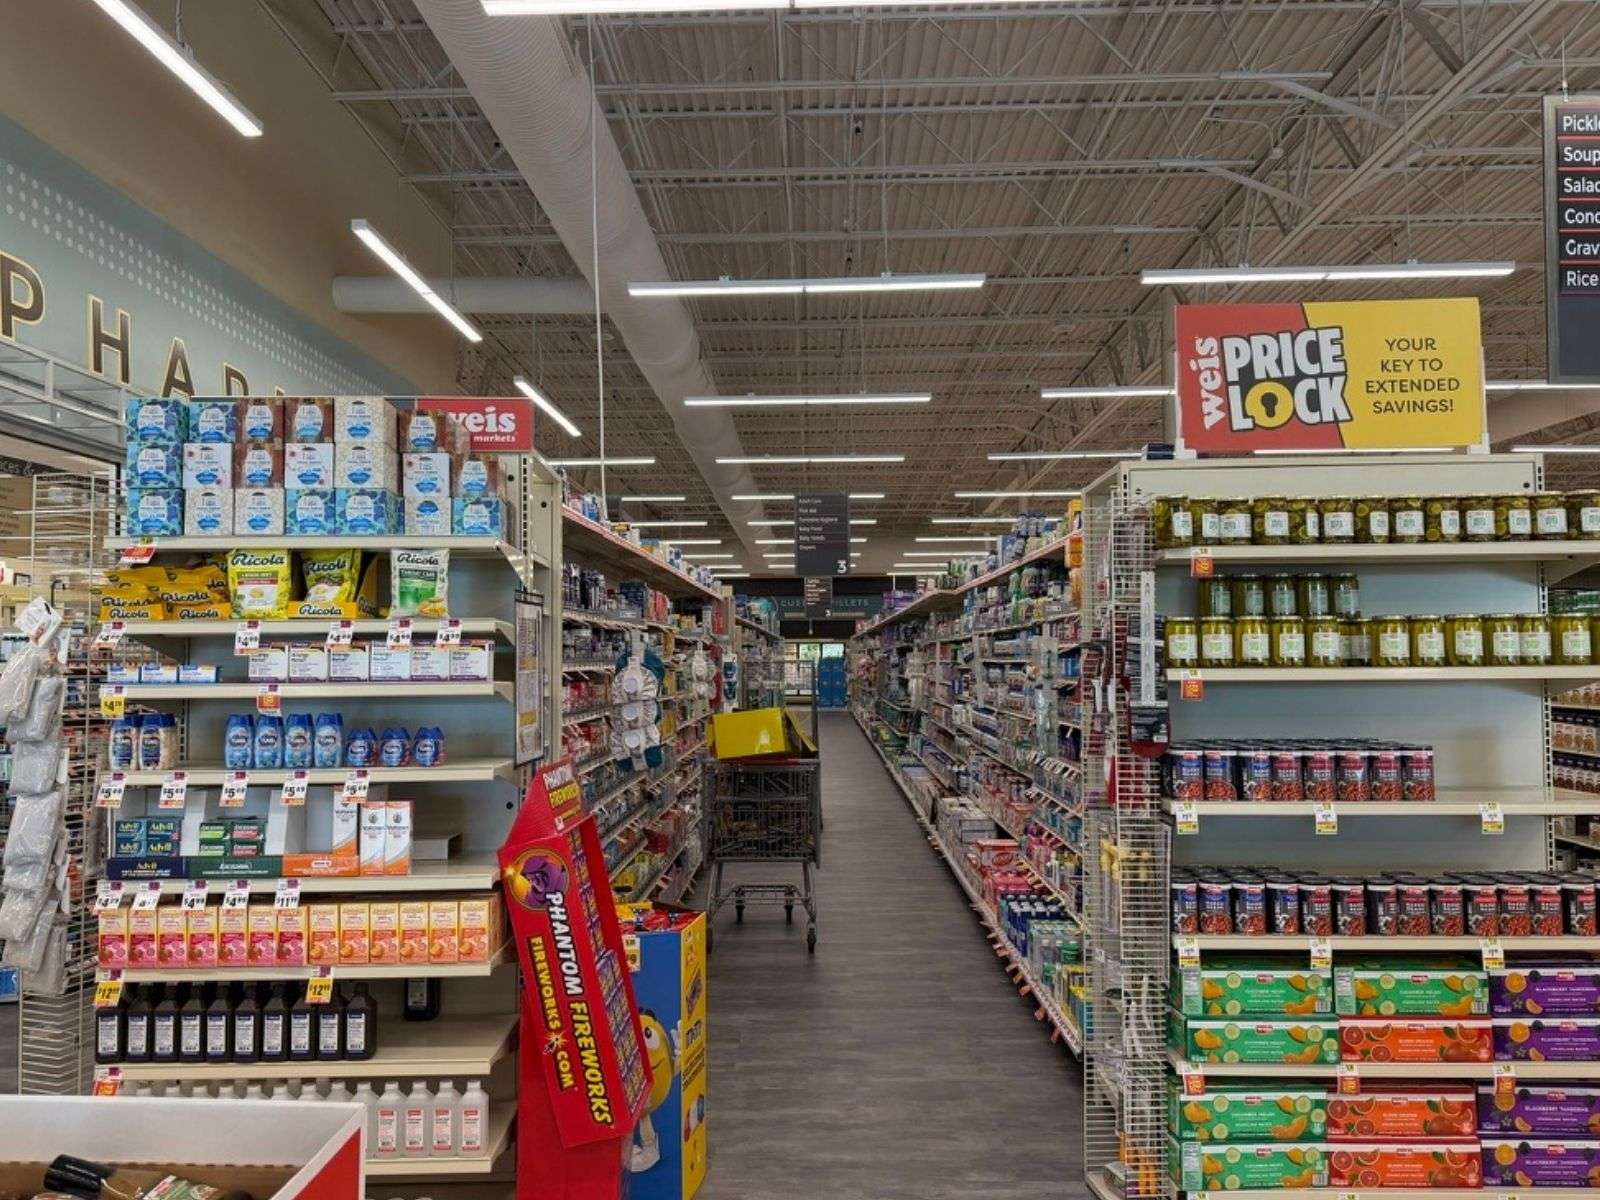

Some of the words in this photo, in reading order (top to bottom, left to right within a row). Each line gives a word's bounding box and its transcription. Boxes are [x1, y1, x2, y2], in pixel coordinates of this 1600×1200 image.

[1563, 115, 1600, 132] Pickl
[1566, 270, 1599, 287] Rice
[1384, 337, 1437, 351] YOUR
[1221, 326, 1346, 382] PRICE
[1380, 358, 1414, 373] KEY
[1418, 357, 1443, 372] TO
[1190, 335, 1227, 431] weis
[1365, 377, 1460, 394] EXTENDED
[1228, 374, 1353, 432] LOCK
[1373, 399, 1454, 414] SAVINGS!
[473, 434, 516, 443] markets
[231, 549, 285, 566] Ricola
[397, 552, 440, 567] Ricola
[837, 559, 847, 574] 3
[109, 608, 149, 619] Ricola
[179, 608, 219, 619] Ricola
[299, 603, 342, 616] Ricola
[119, 822, 139, 831] Advil
[151, 822, 174, 831] Advil
[137, 862, 157, 870] Advil
[545, 890, 584, 996] PHANTOM
[527, 935, 563, 1031] FIREWORKS
[568, 999, 615, 1128] FIREWORKS
